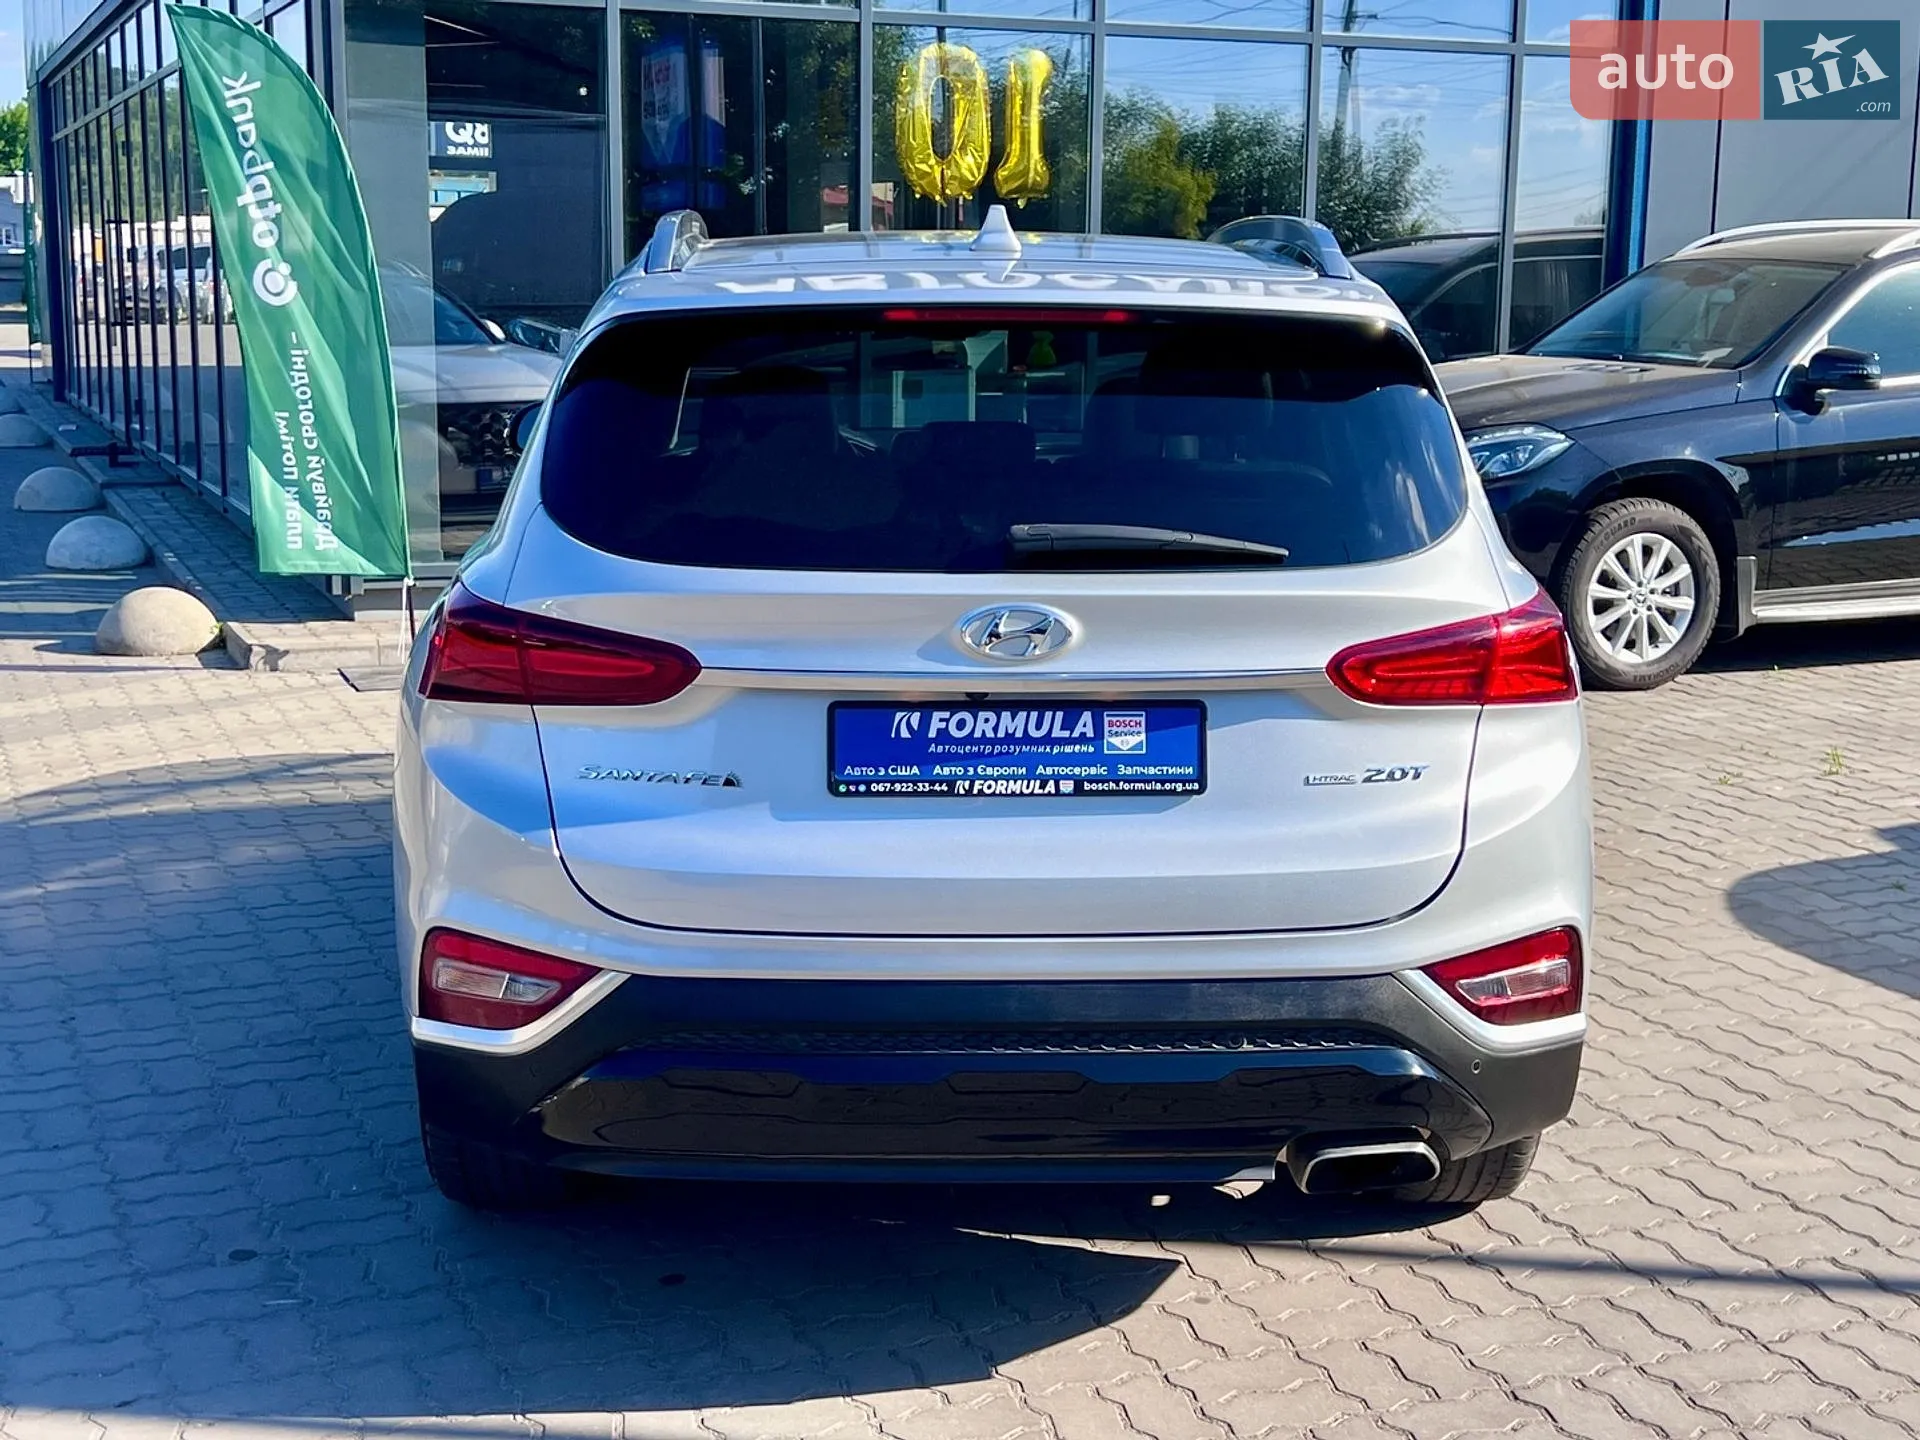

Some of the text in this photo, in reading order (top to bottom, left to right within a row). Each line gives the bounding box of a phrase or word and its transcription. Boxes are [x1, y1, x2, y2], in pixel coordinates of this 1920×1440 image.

[928, 711, 1095, 739] FORMULA
[1107, 719, 1142, 729] BOSCH
[1107, 729, 1143, 738] Service
[928, 743, 1095, 755] Автоцентр розумних рішень
[844, 765, 875, 776] Авто
[888, 766, 920, 776] США
[933, 765, 965, 776] Авто
[977, 765, 1027, 777] Європи
[1036, 764, 1108, 777] Автосервіс
[1117, 764, 1194, 775] Запчастини
[972, 780, 1056, 795] FORMULA
[1083, 781, 1200, 792] bosch.formula.org.ua
